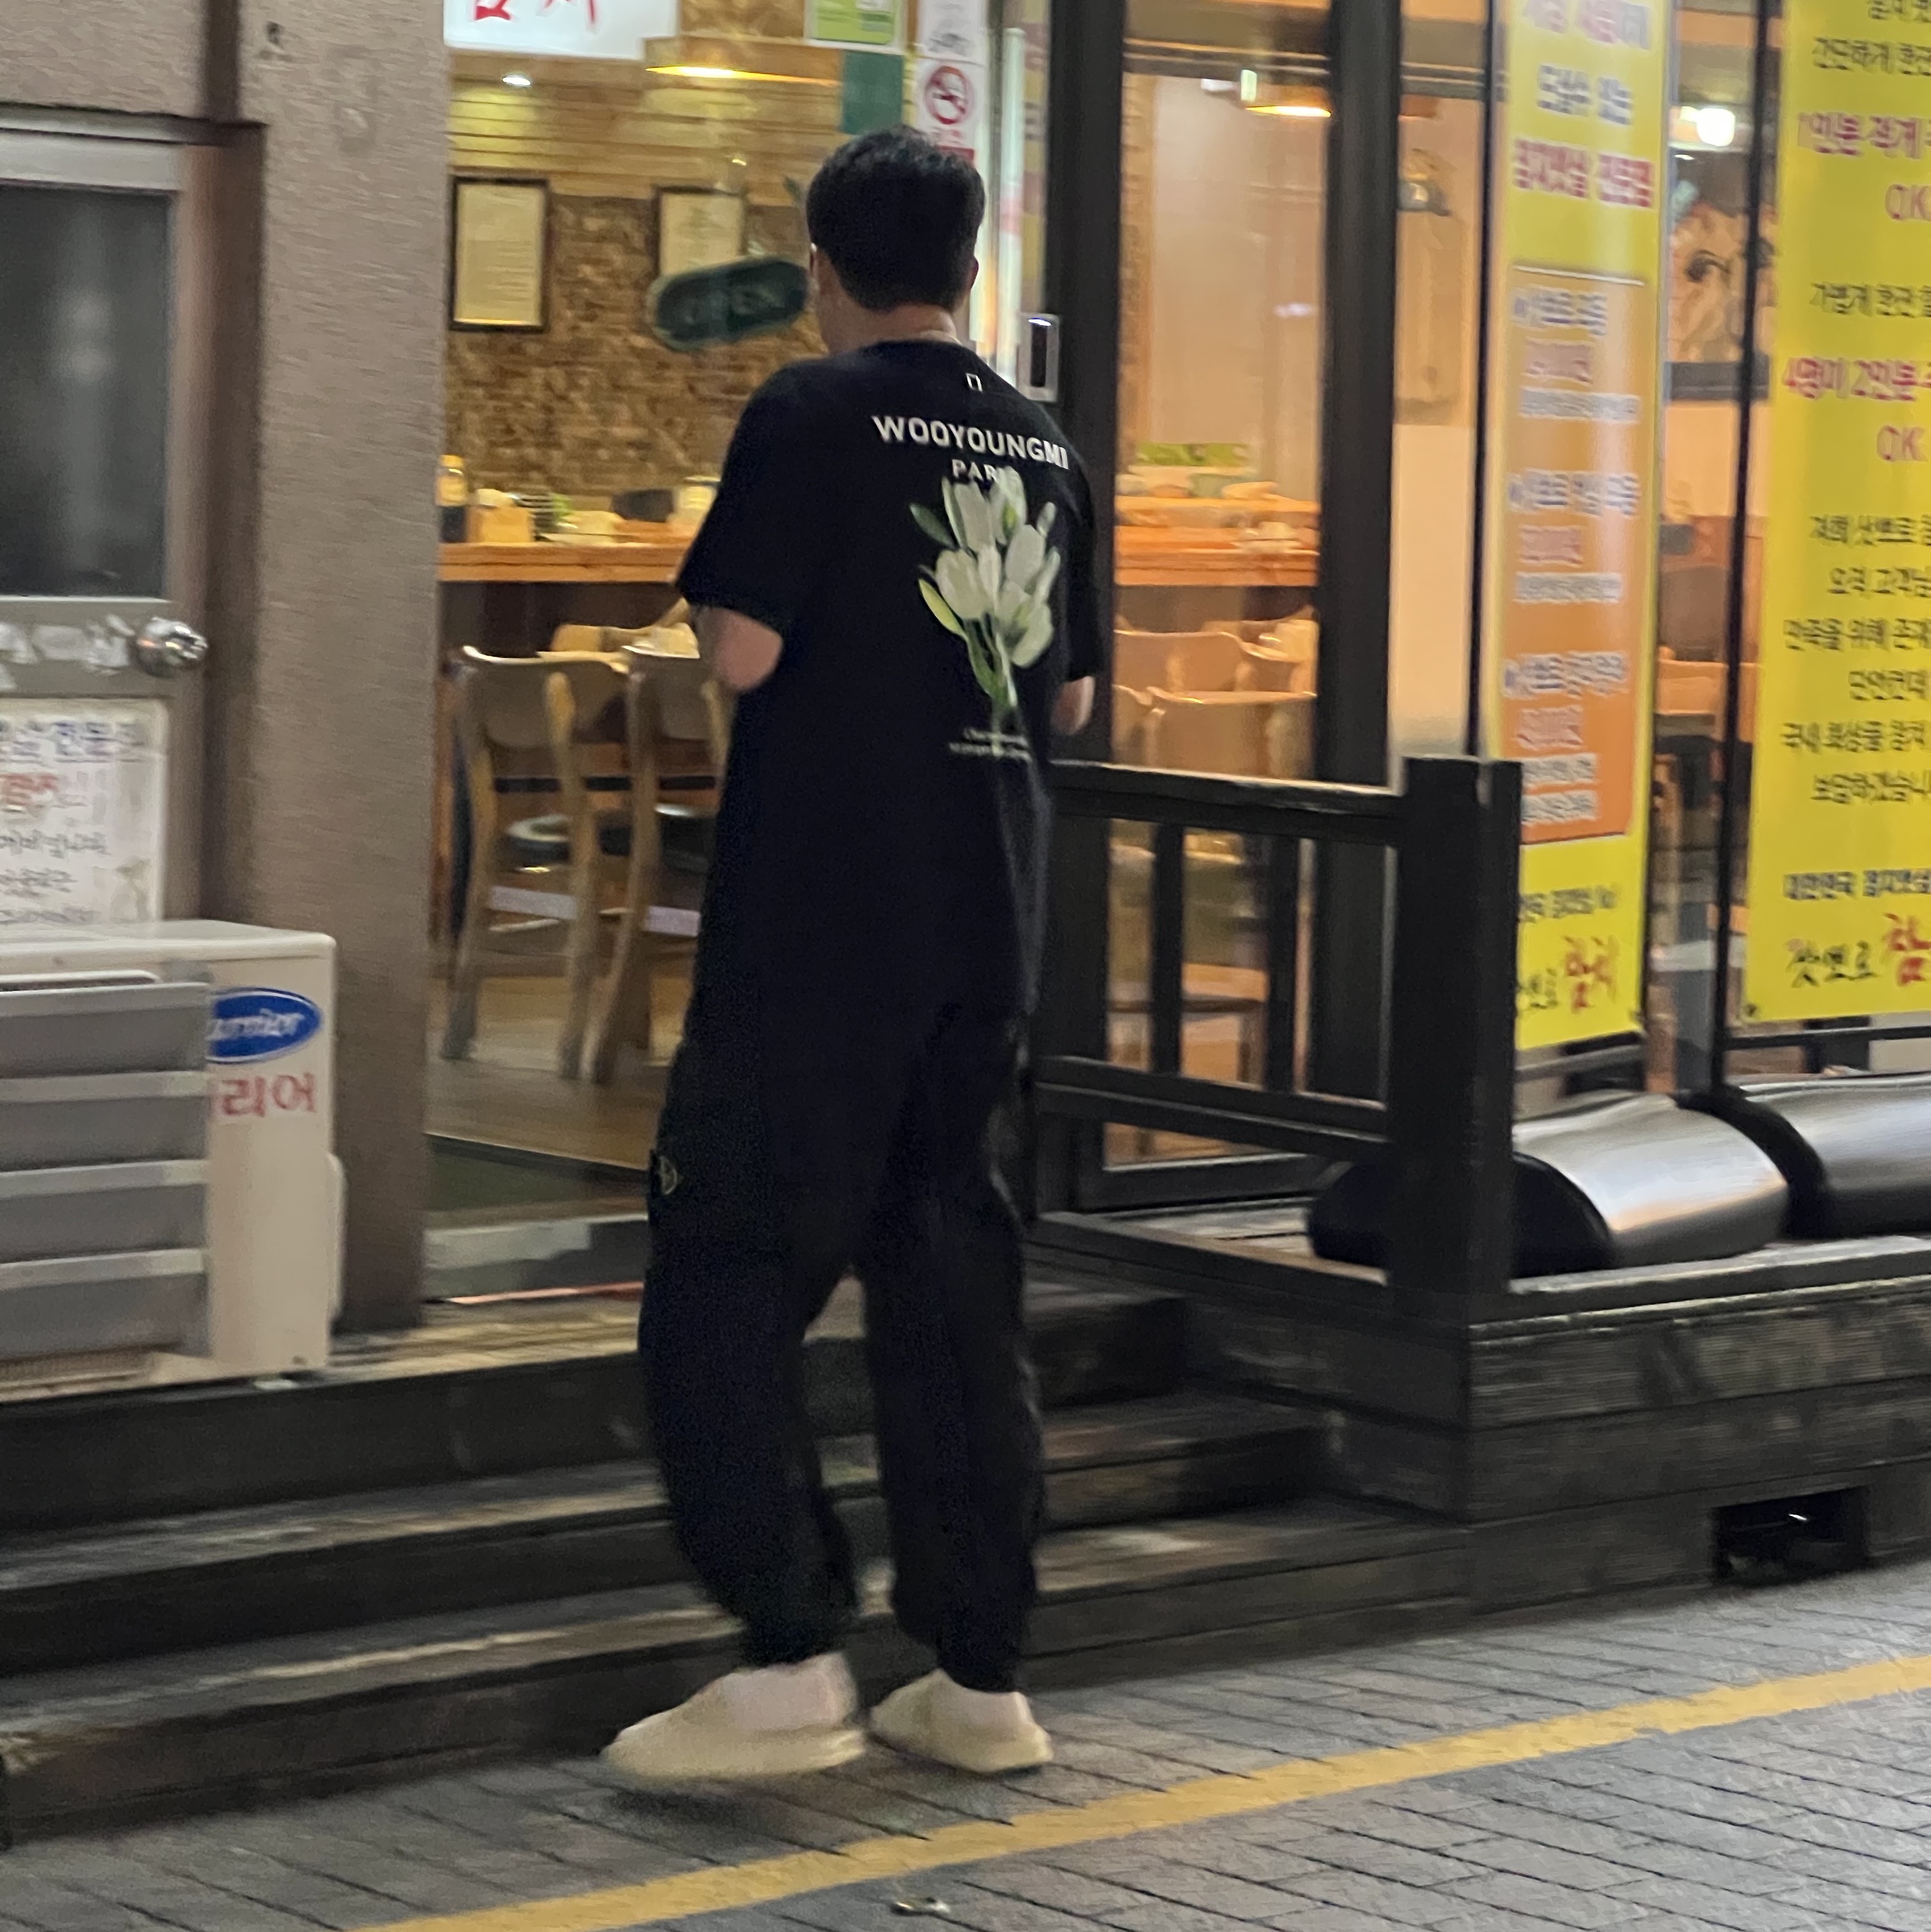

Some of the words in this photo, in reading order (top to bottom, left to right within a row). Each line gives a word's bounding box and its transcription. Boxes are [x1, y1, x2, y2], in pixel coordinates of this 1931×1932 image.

[871, 415, 1069, 470] WOOYOUNGMI
[1877, 425, 1927, 462] OK
[220, 1072, 315, 1117] 리어
